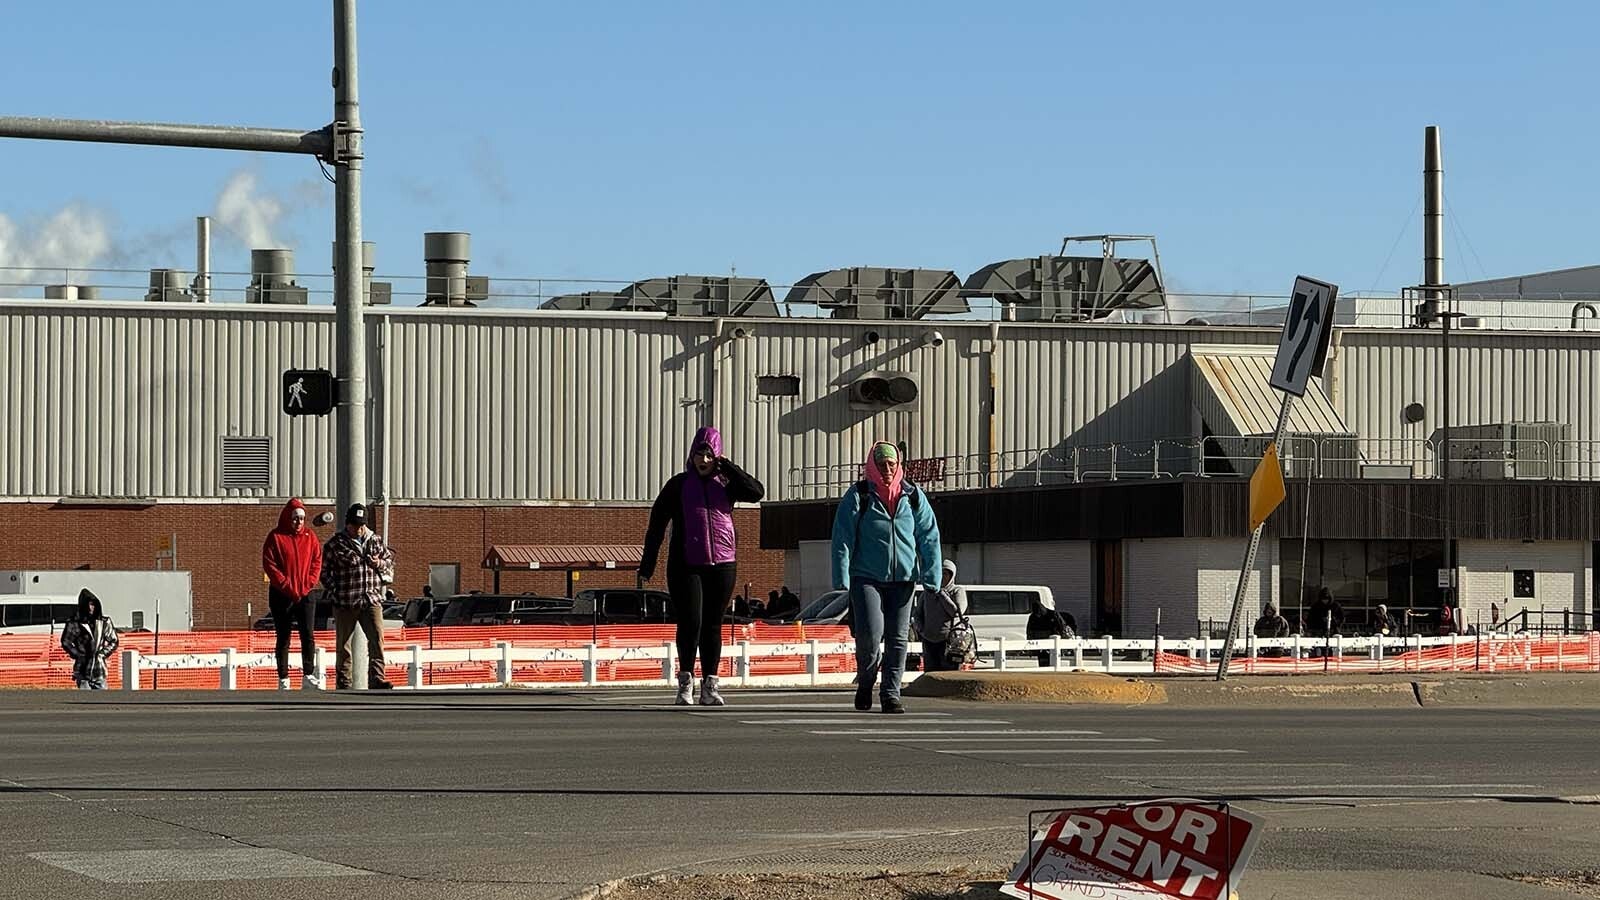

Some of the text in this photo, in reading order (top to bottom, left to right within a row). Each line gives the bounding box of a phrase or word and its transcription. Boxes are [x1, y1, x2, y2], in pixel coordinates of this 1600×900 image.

[1094, 805, 1217, 854] OR
[1058, 814, 1219, 897] RENT
[1033, 863, 1106, 899] GRAND
